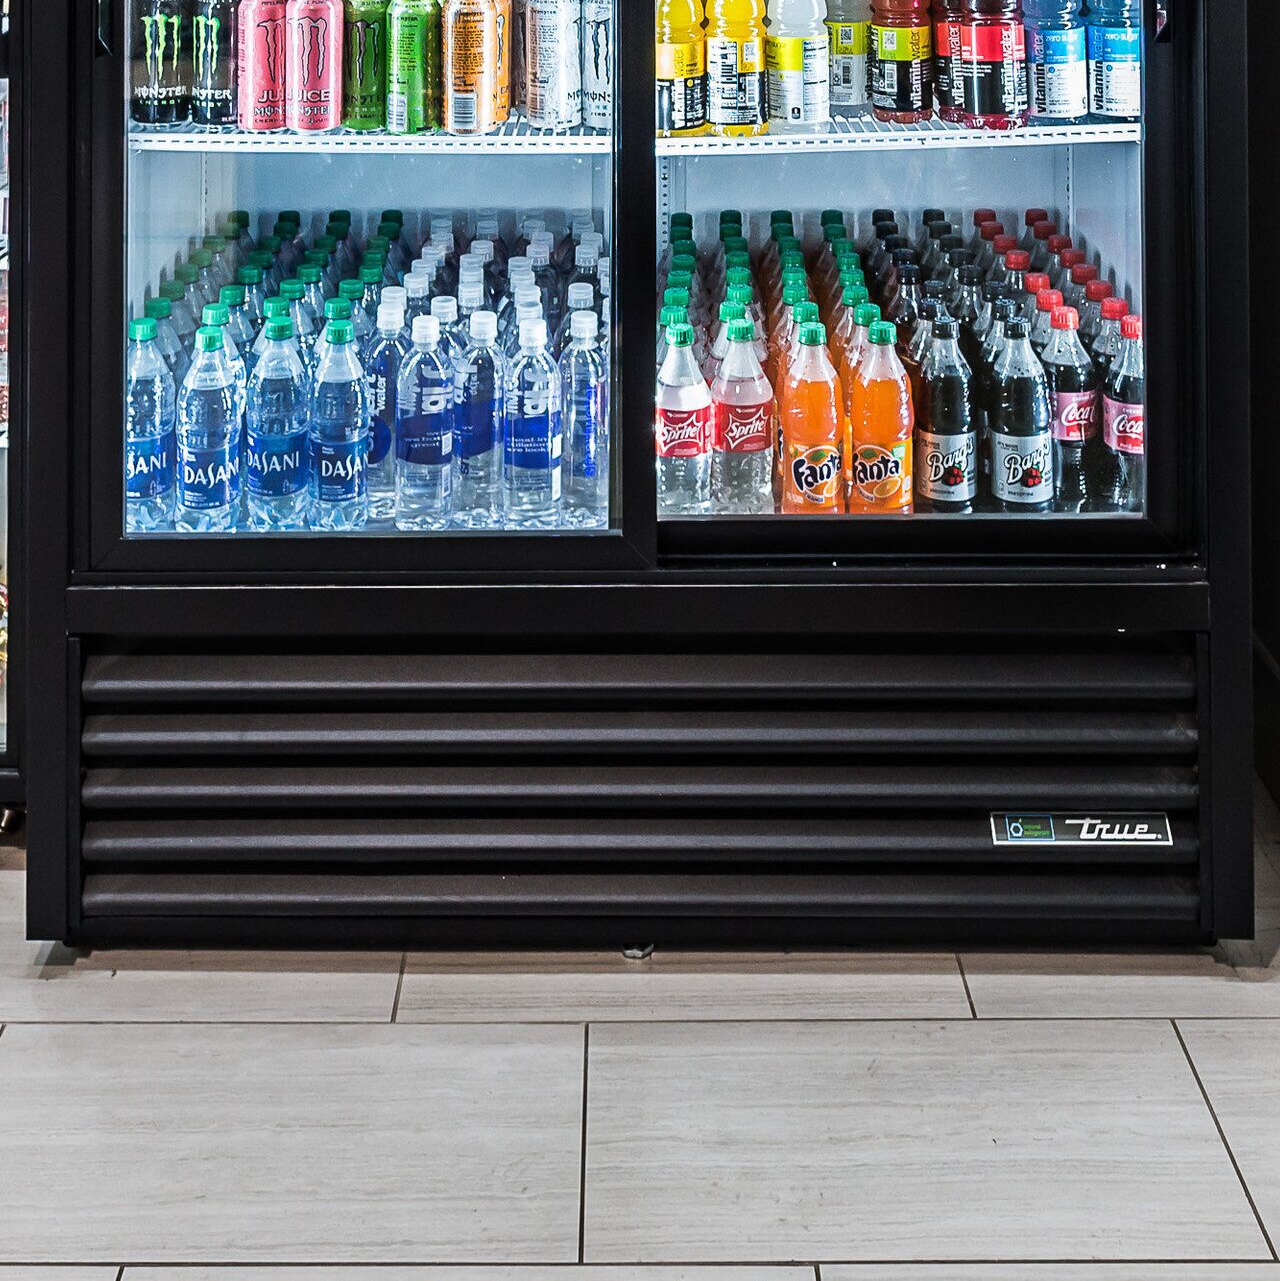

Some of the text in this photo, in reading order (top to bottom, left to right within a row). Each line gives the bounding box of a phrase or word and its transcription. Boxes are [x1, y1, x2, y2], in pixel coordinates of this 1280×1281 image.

[909, 29, 924, 110] vitaminwater
[1034, 31, 1047, 114] vitaminwater
[1094, 30, 1106, 112] vitaminwater
[375, 375, 386, 411] water
[662, 425, 699, 443] Sprite
[730, 419, 765, 437] Sprite
[183, 457, 240, 489] DASANI
[246, 451, 300, 475] DASANI
[926, 436, 975, 483] Barq's
[1004, 438, 1052, 486] Barq's
